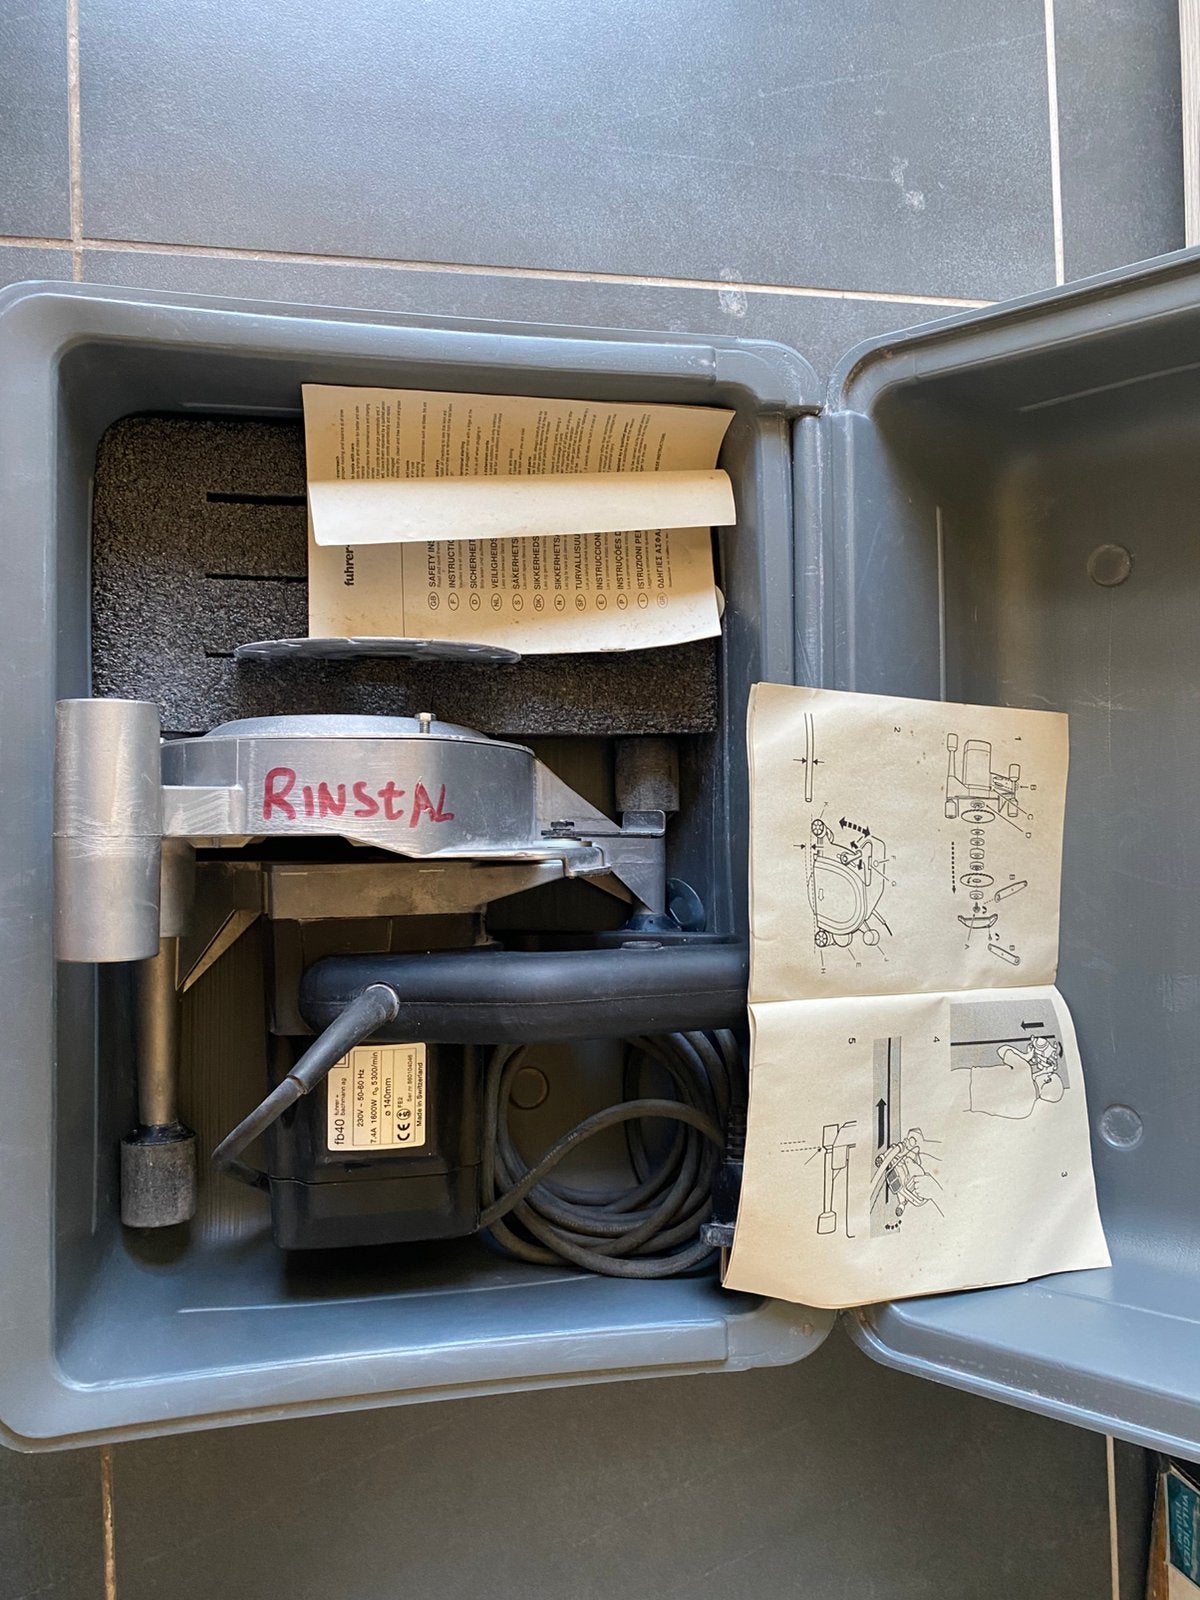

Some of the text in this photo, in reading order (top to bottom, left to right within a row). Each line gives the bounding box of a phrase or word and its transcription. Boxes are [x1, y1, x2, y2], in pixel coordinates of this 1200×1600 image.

[344, 545, 354, 586] fuhrer
[428, 555, 436, 587] SAFETY
[533, 536, 541, 590] SIKKERHEDS
[636, 546, 644, 589] ISTRUZIONI
[358, 1069, 364, 1078] Hz
[334, 1119, 345, 1145] fb40
[397, 1123, 410, 1141] CE
